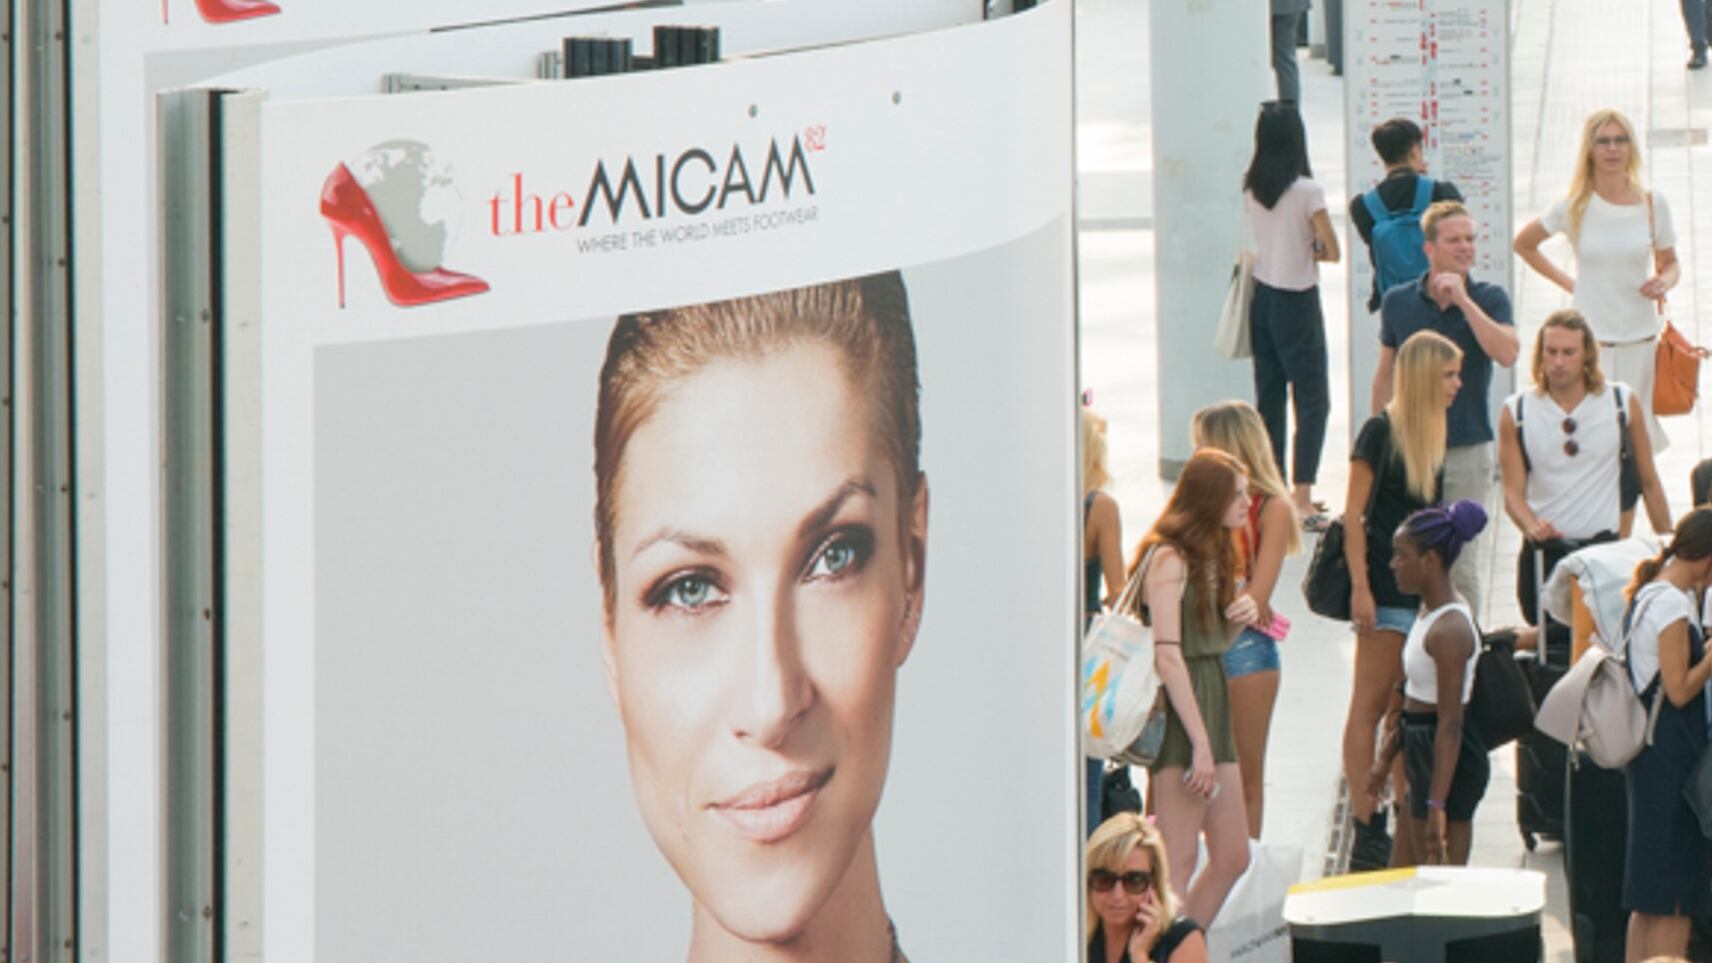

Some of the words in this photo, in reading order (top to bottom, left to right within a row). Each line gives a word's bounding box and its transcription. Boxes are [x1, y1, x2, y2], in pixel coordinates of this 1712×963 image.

[577, 233, 628, 254] WHERE
[632, 229, 657, 248] THE
[660, 223, 711, 243] WORLD
[712, 216, 752, 236] MEETS
[754, 205, 819, 231] FOOTWEAR
